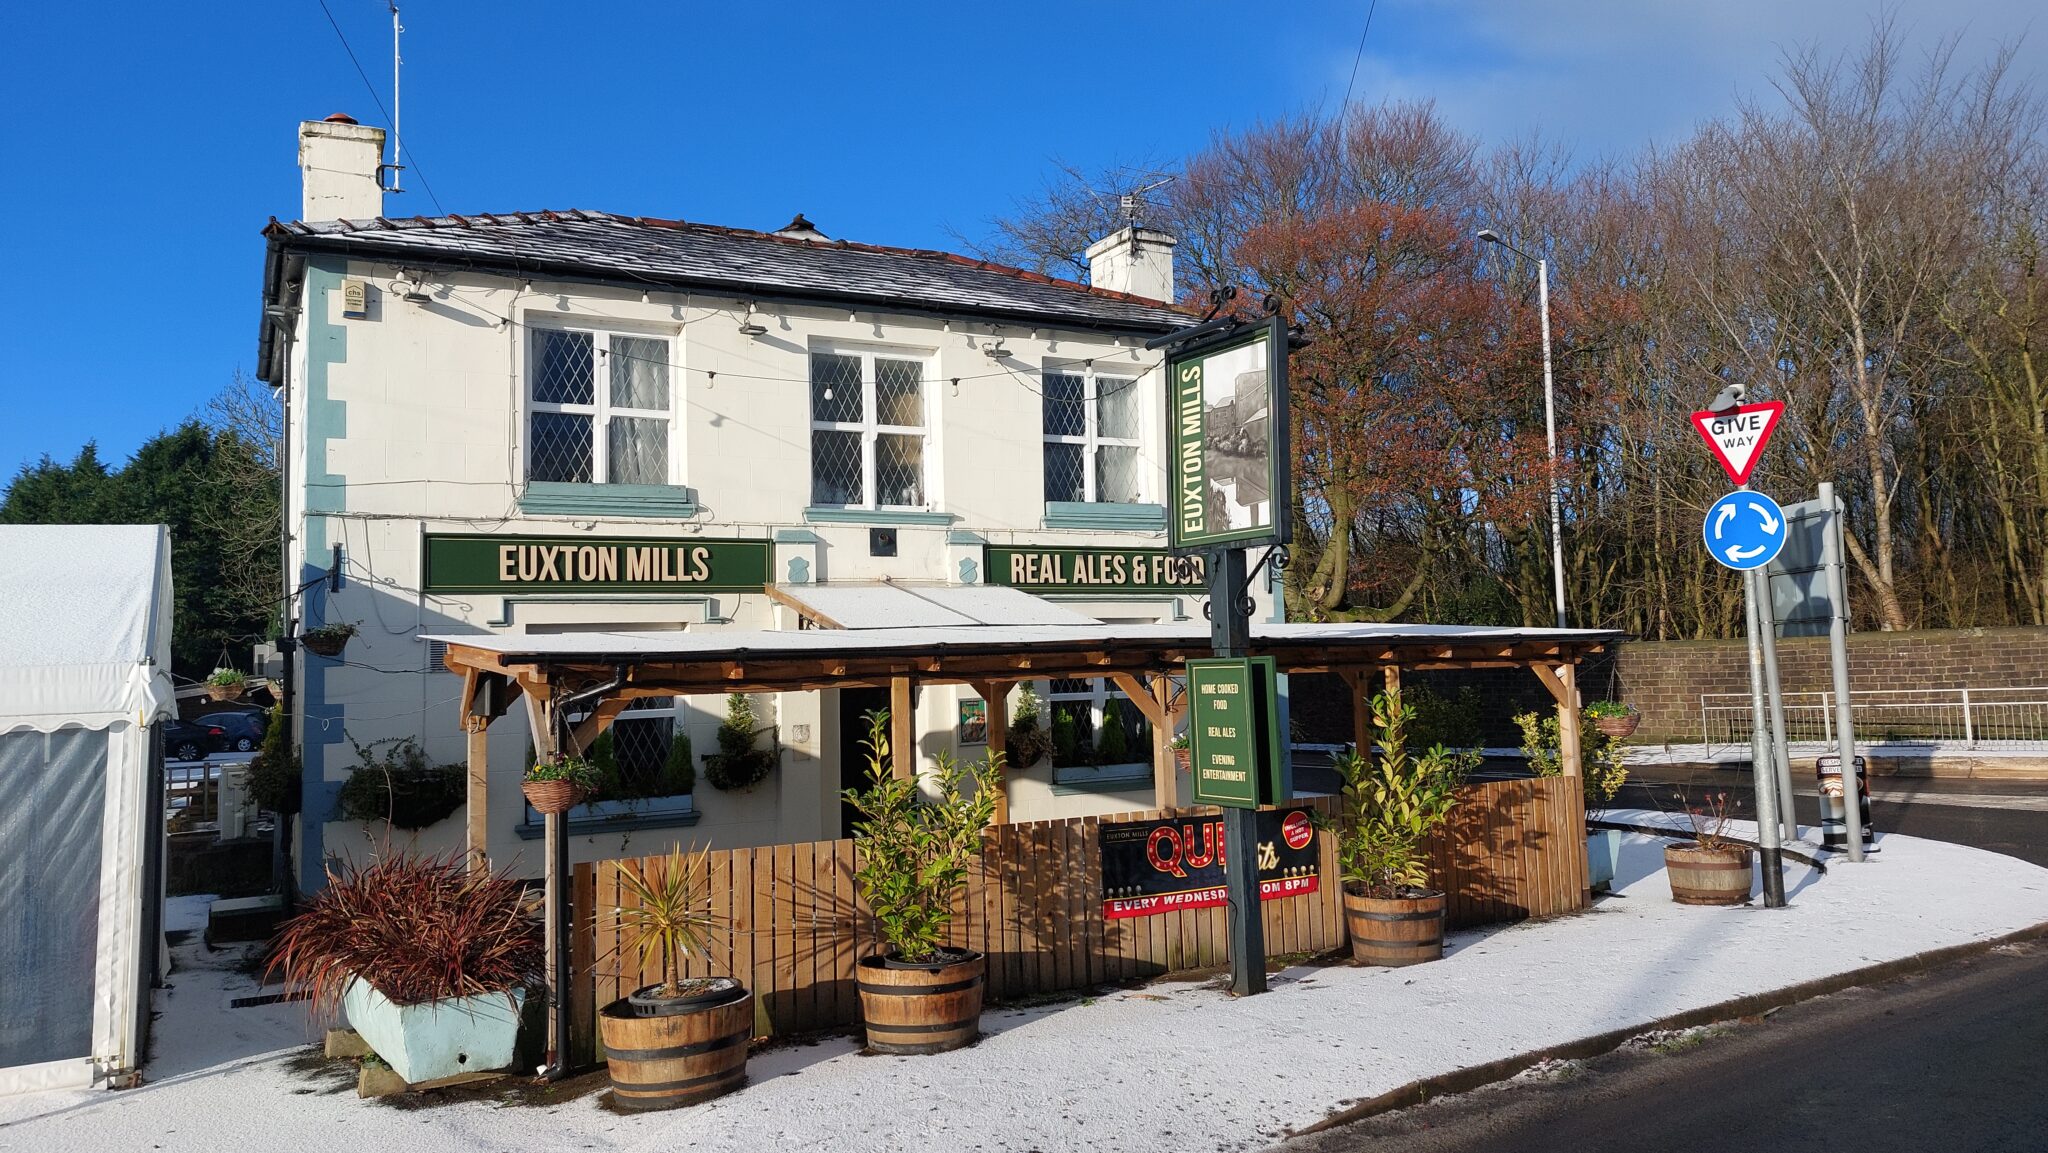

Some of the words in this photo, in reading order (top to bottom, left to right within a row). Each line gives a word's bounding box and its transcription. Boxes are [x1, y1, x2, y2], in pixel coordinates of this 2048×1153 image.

[1182, 365, 1201, 437] MILLS
[1711, 415, 1761, 435] GIVE
[1723, 435, 1754, 448] WAY
[1183, 440, 1203, 533] EUXTON
[499, 545, 618, 582] EUXTON
[626, 547, 709, 582] MILLS
[1010, 554, 1067, 584] REAL
[1073, 555, 1126, 584] ALES
[1132, 556, 1147, 585] &
[1152, 556, 1205, 585] FOOD
[1201, 684, 1216, 694] HOME
[1217, 683, 1239, 694] COOKED
[1213, 700, 1228, 710] FOOD
[1208, 727, 1222, 737] REAL
[1222, 727, 1236, 738] ALES
[1212, 754, 1235, 765] EVENING
[1202, 769, 1246, 782] ENTERTAINMENT
[1106, 832, 1130, 840] EUXTON
[1132, 830, 1149, 838] MILLS
[1290, 832, 1309, 843] SUPPER
[1113, 898, 1159, 912] EVERY
[1164, 889, 1226, 904] WEDNESD
[1285, 878, 1309, 890] 8PM
